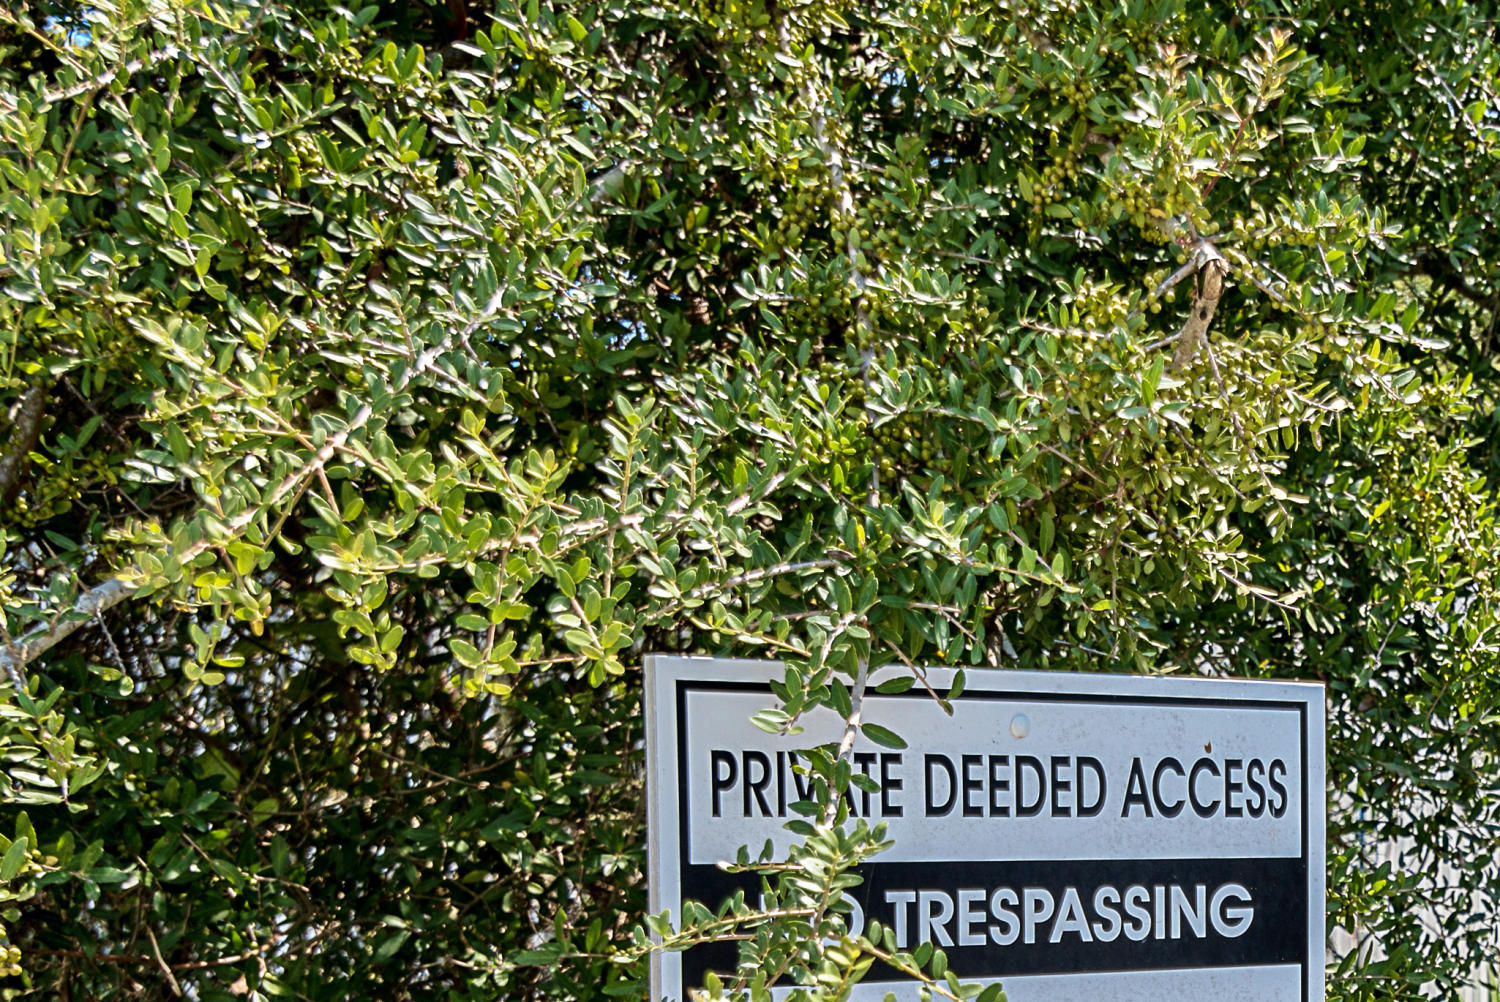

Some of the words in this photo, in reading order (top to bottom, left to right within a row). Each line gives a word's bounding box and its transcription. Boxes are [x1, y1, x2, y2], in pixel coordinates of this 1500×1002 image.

[711, 750, 904, 818] PRIVTE
[924, 753, 1108, 818] DEEDED
[1120, 756, 1289, 819] ACCESS
[884, 884, 1255, 949] TRESPASSING
